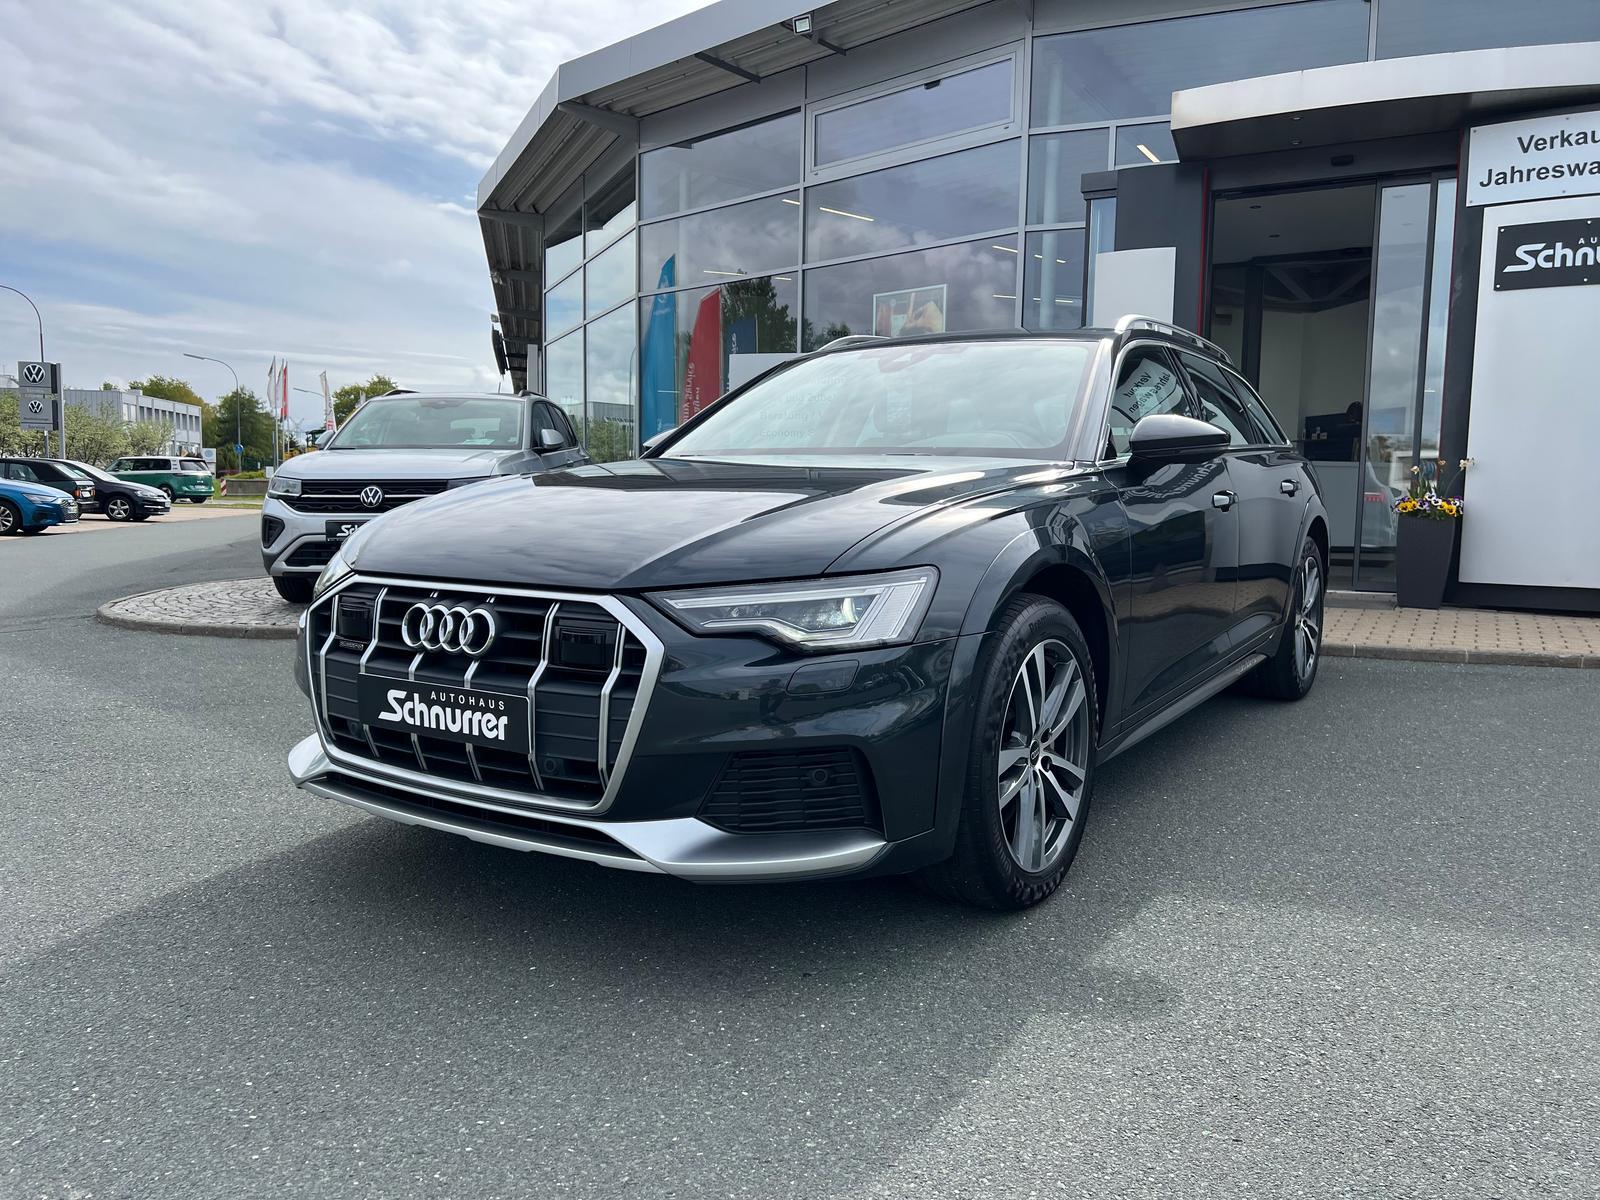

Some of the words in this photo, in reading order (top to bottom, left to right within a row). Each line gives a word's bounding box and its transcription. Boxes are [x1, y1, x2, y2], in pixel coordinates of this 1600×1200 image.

[1479, 160, 1600, 188] Jahreswa
[1502, 242, 1600, 273] Schn
[377, 689, 508, 741] Schnurrer
[430, 690, 505, 711] AUTOHAUS
